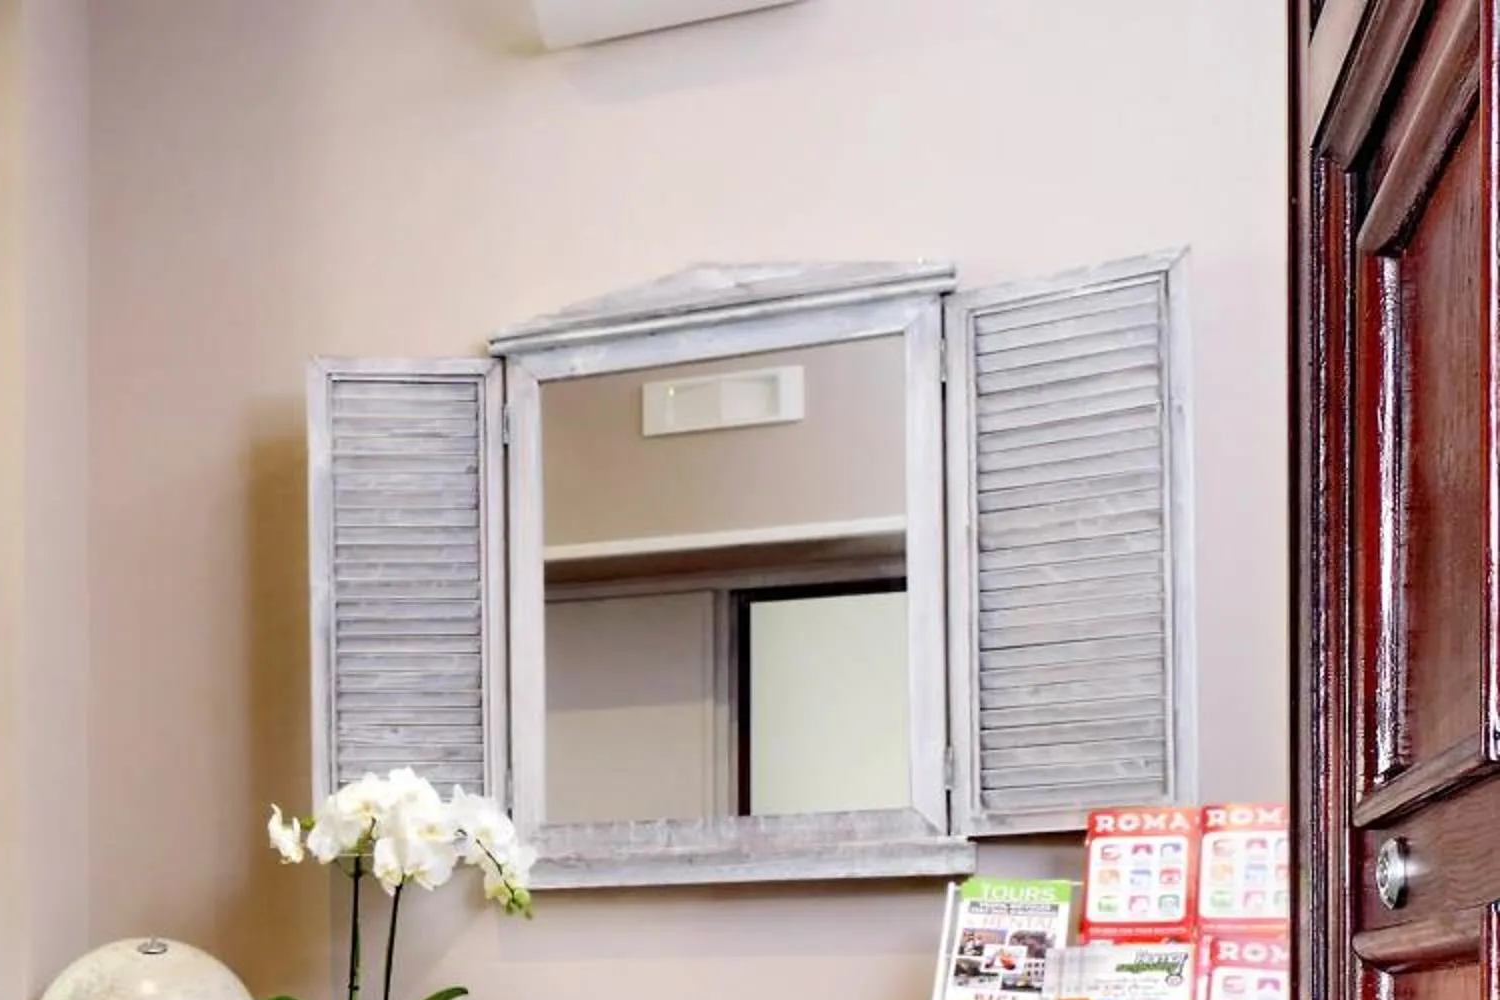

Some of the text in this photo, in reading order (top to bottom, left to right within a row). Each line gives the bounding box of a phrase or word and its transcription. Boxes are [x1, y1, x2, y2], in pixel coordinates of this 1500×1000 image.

[1095, 813, 1190, 832] ROMA
[1206, 807, 1287, 827] ROM
[980, 884, 1056, 902] TOURS
